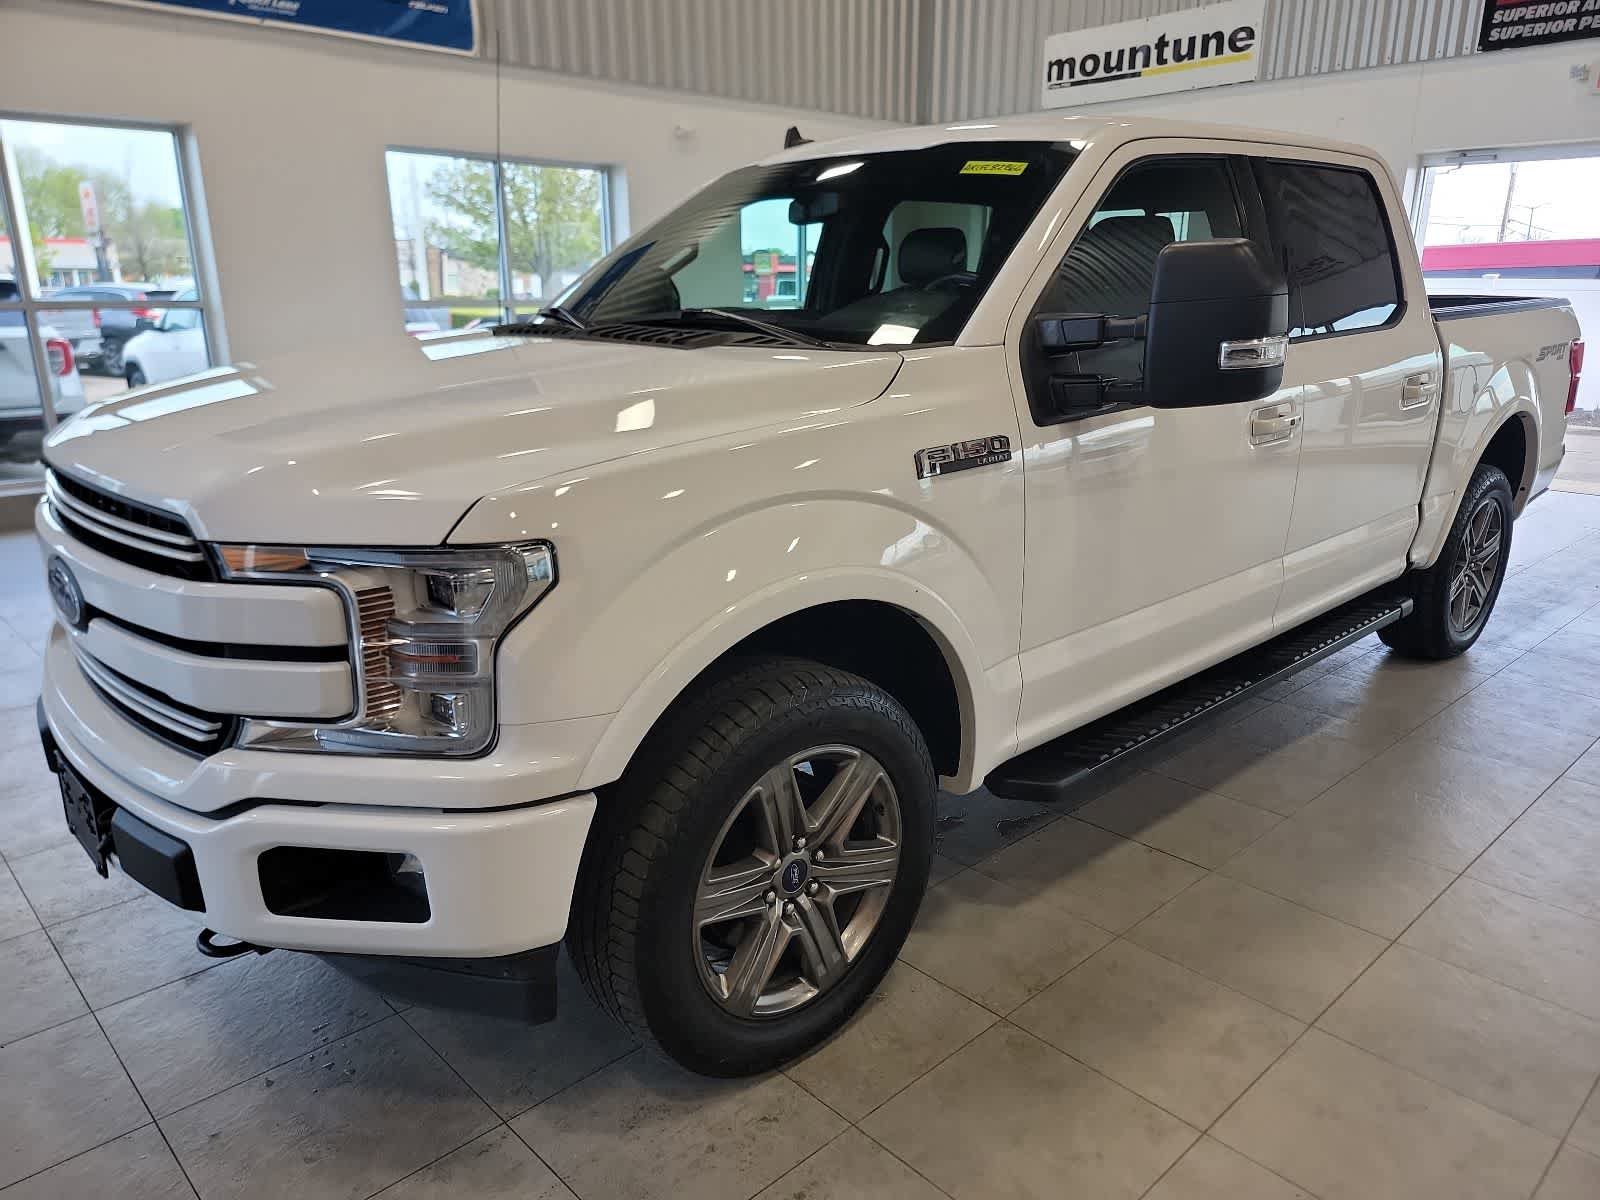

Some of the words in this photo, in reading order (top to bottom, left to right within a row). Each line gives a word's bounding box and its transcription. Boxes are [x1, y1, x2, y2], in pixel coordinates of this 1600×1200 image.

[1492, 1, 1580, 24] SUPERIOR
[1488, 18, 1577, 41] SUPERIOR
[1047, 26, 1256, 82] mountune
